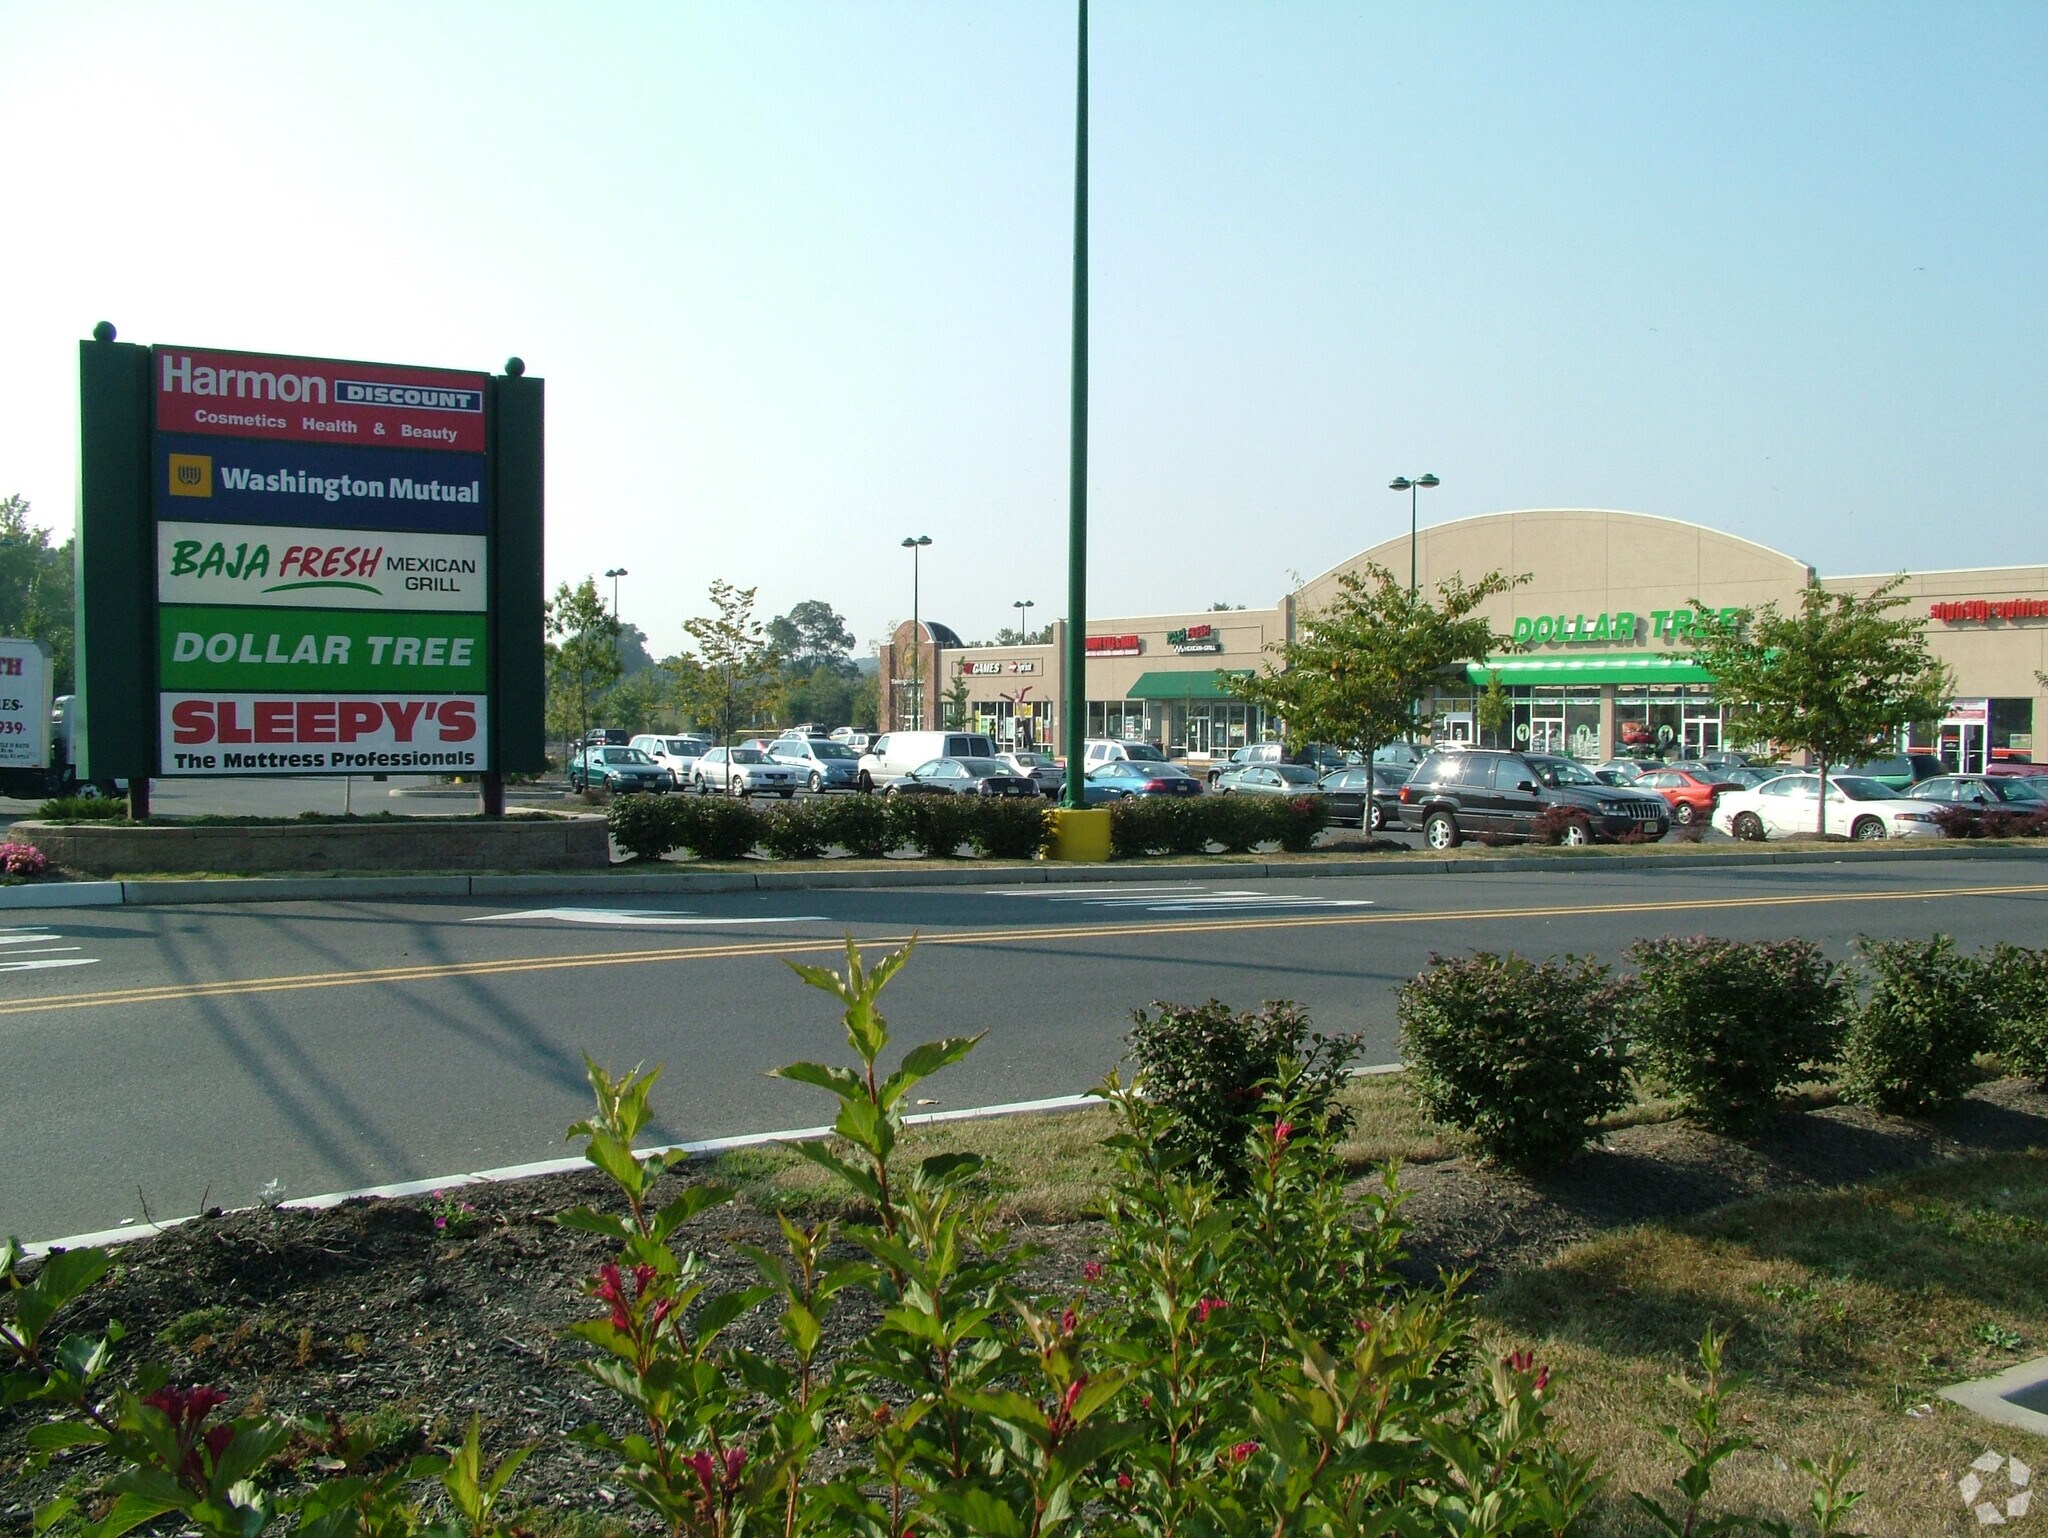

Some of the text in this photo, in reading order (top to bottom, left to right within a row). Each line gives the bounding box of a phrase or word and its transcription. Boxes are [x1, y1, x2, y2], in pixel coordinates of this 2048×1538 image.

[162, 354, 471, 408] Harmon DISCOUNT
[194, 409, 458, 443] Cosmetics Health & Beauty
[221, 466, 480, 503] Washington Mutual
[170, 540, 385, 580] BAJA FRESH
[386, 556, 476, 574] MEXICAN
[404, 576, 461, 592] GRILL
[1514, 612, 1636, 644] DOLLAR
[172, 632, 475, 667] DOLLAR TREE
[973, 663, 1001, 674] GAMES
[172, 700, 477, 745] SLEEPY'S
[174, 750, 475, 768] The Mattress Professionals
